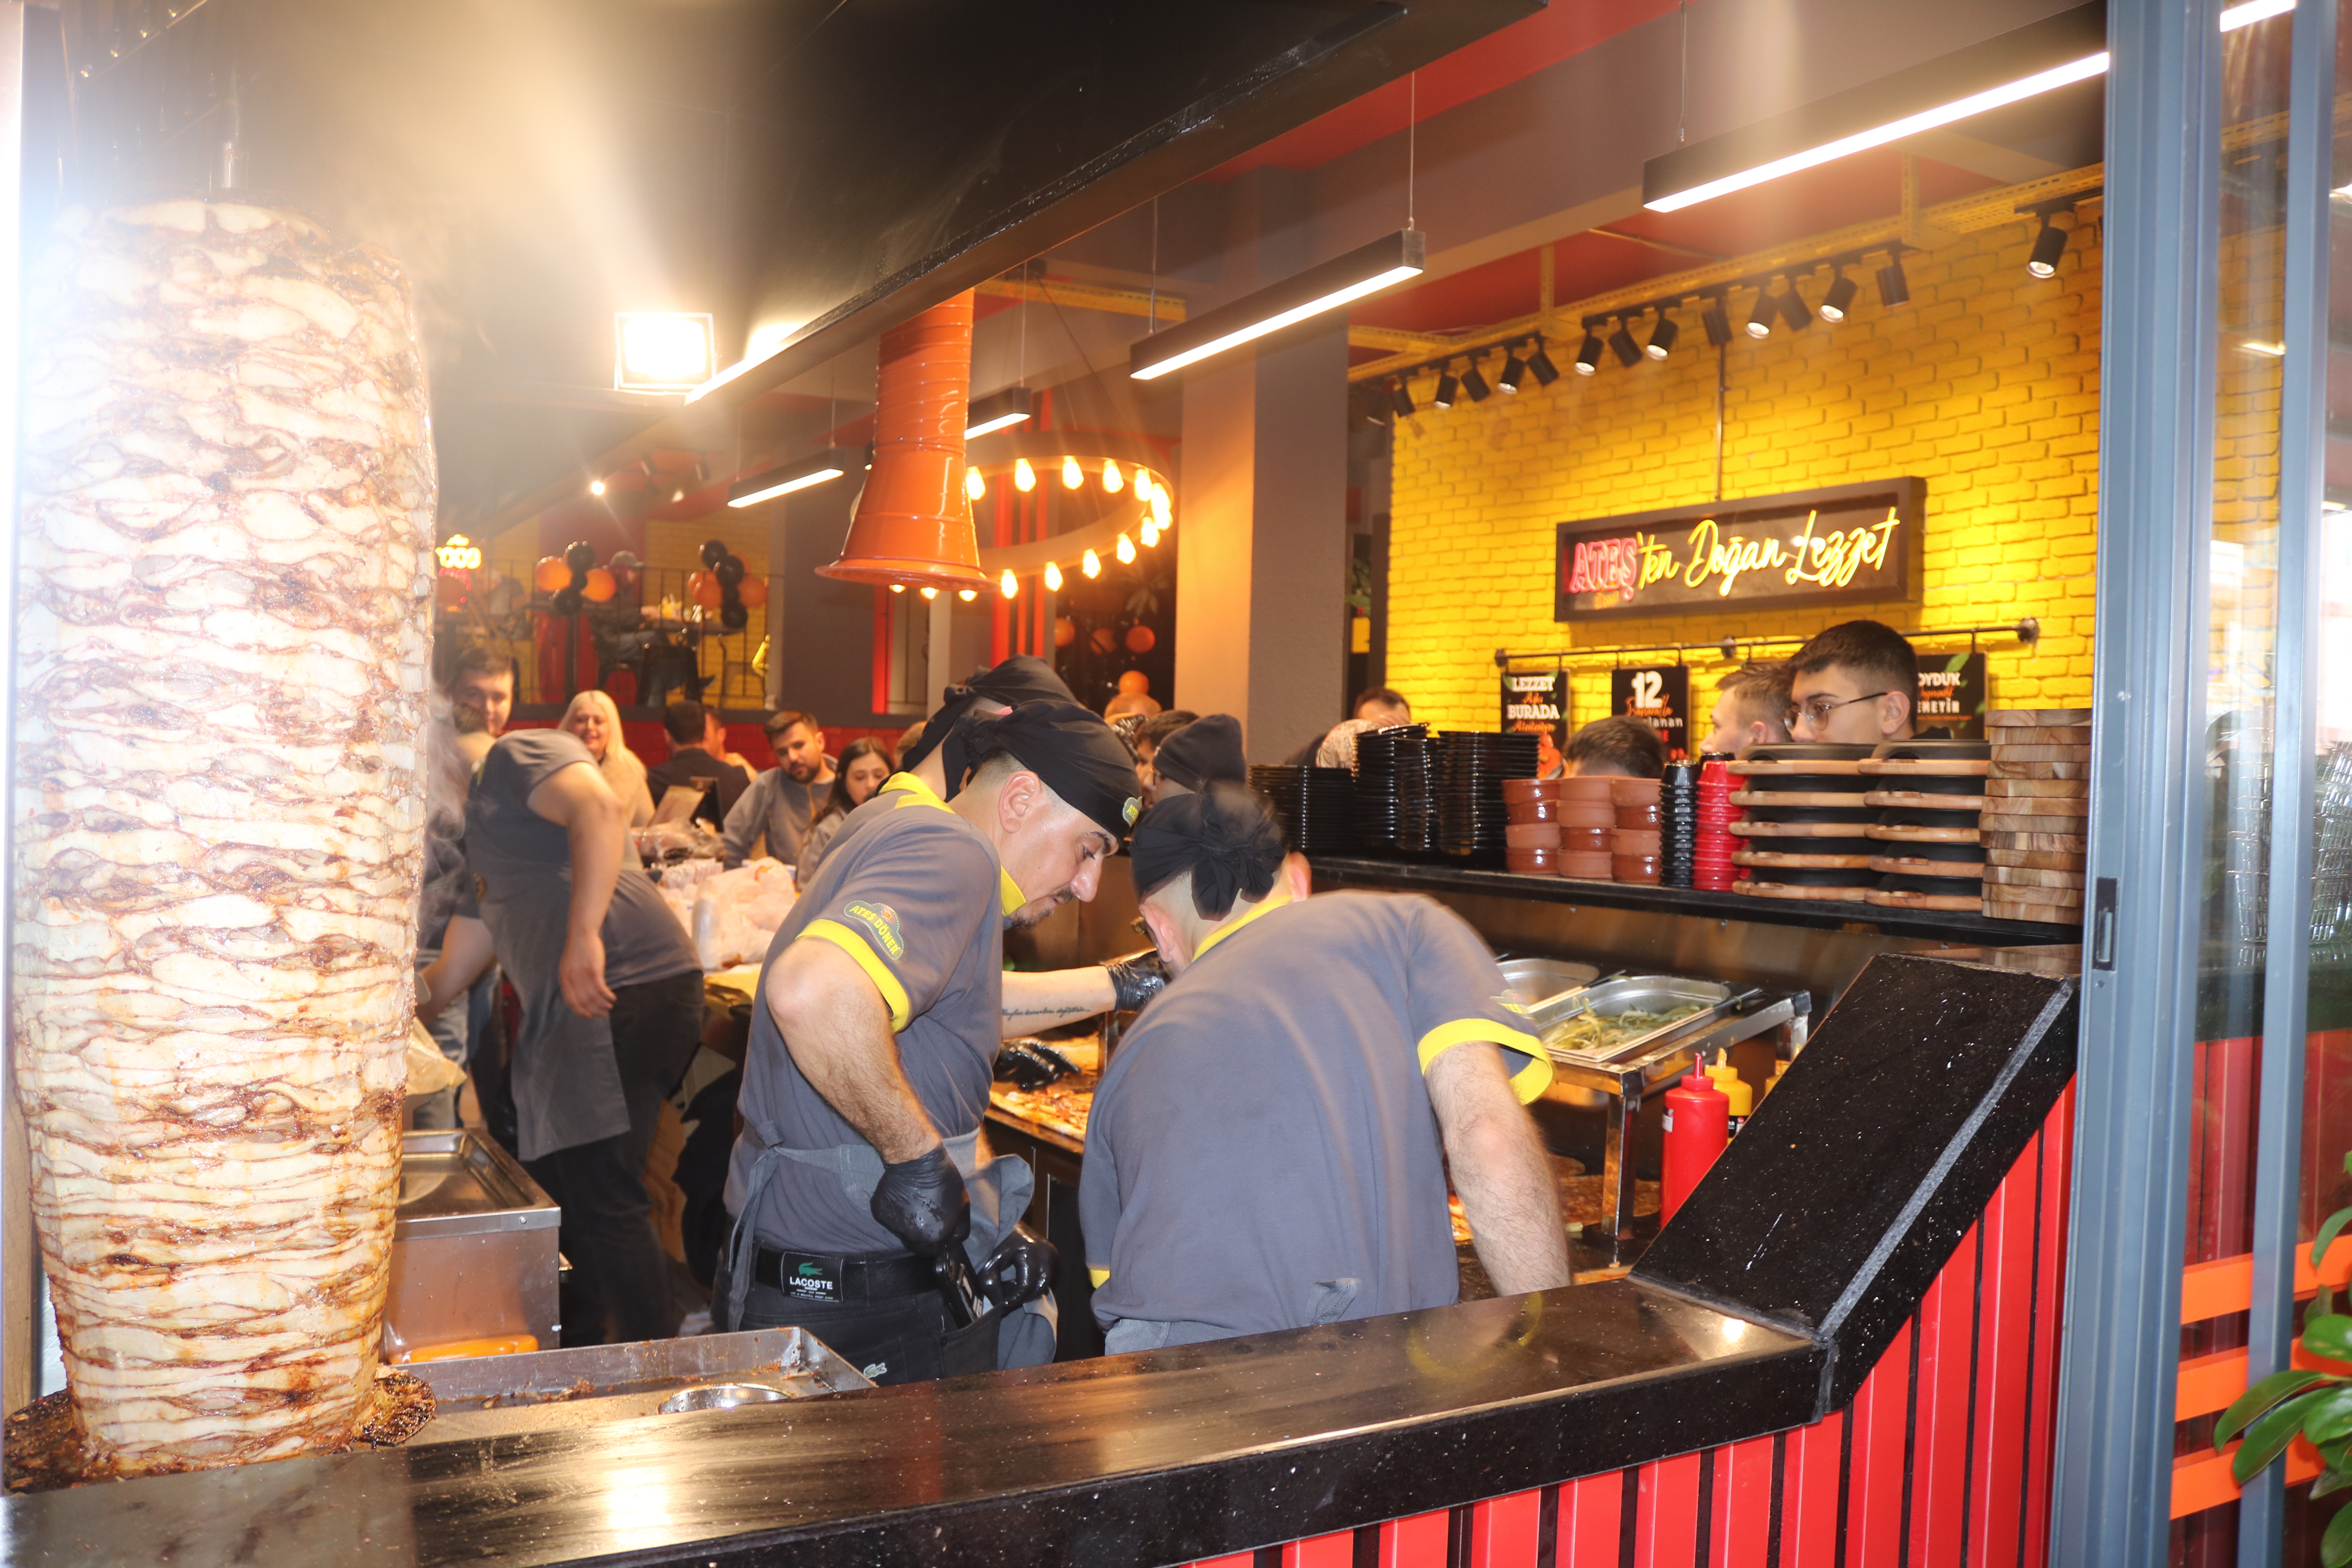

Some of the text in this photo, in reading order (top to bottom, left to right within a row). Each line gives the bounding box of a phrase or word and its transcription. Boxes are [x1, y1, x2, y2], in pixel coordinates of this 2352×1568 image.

[1684, 519, 1788, 597] Doğan
[1784, 506, 1901, 588] Lezzet
[1512, 676, 1556, 692] LEZZET
[1917, 672, 1961, 686] OYDUK
[1631, 670, 1663, 709] 12
[1506, 704, 1561, 720] BURADA
[1917, 697, 1960, 713] EMEYİN
[849, 905, 899, 955] ATES DÖNER
[789, 1276, 833, 1290] LACOSTE
